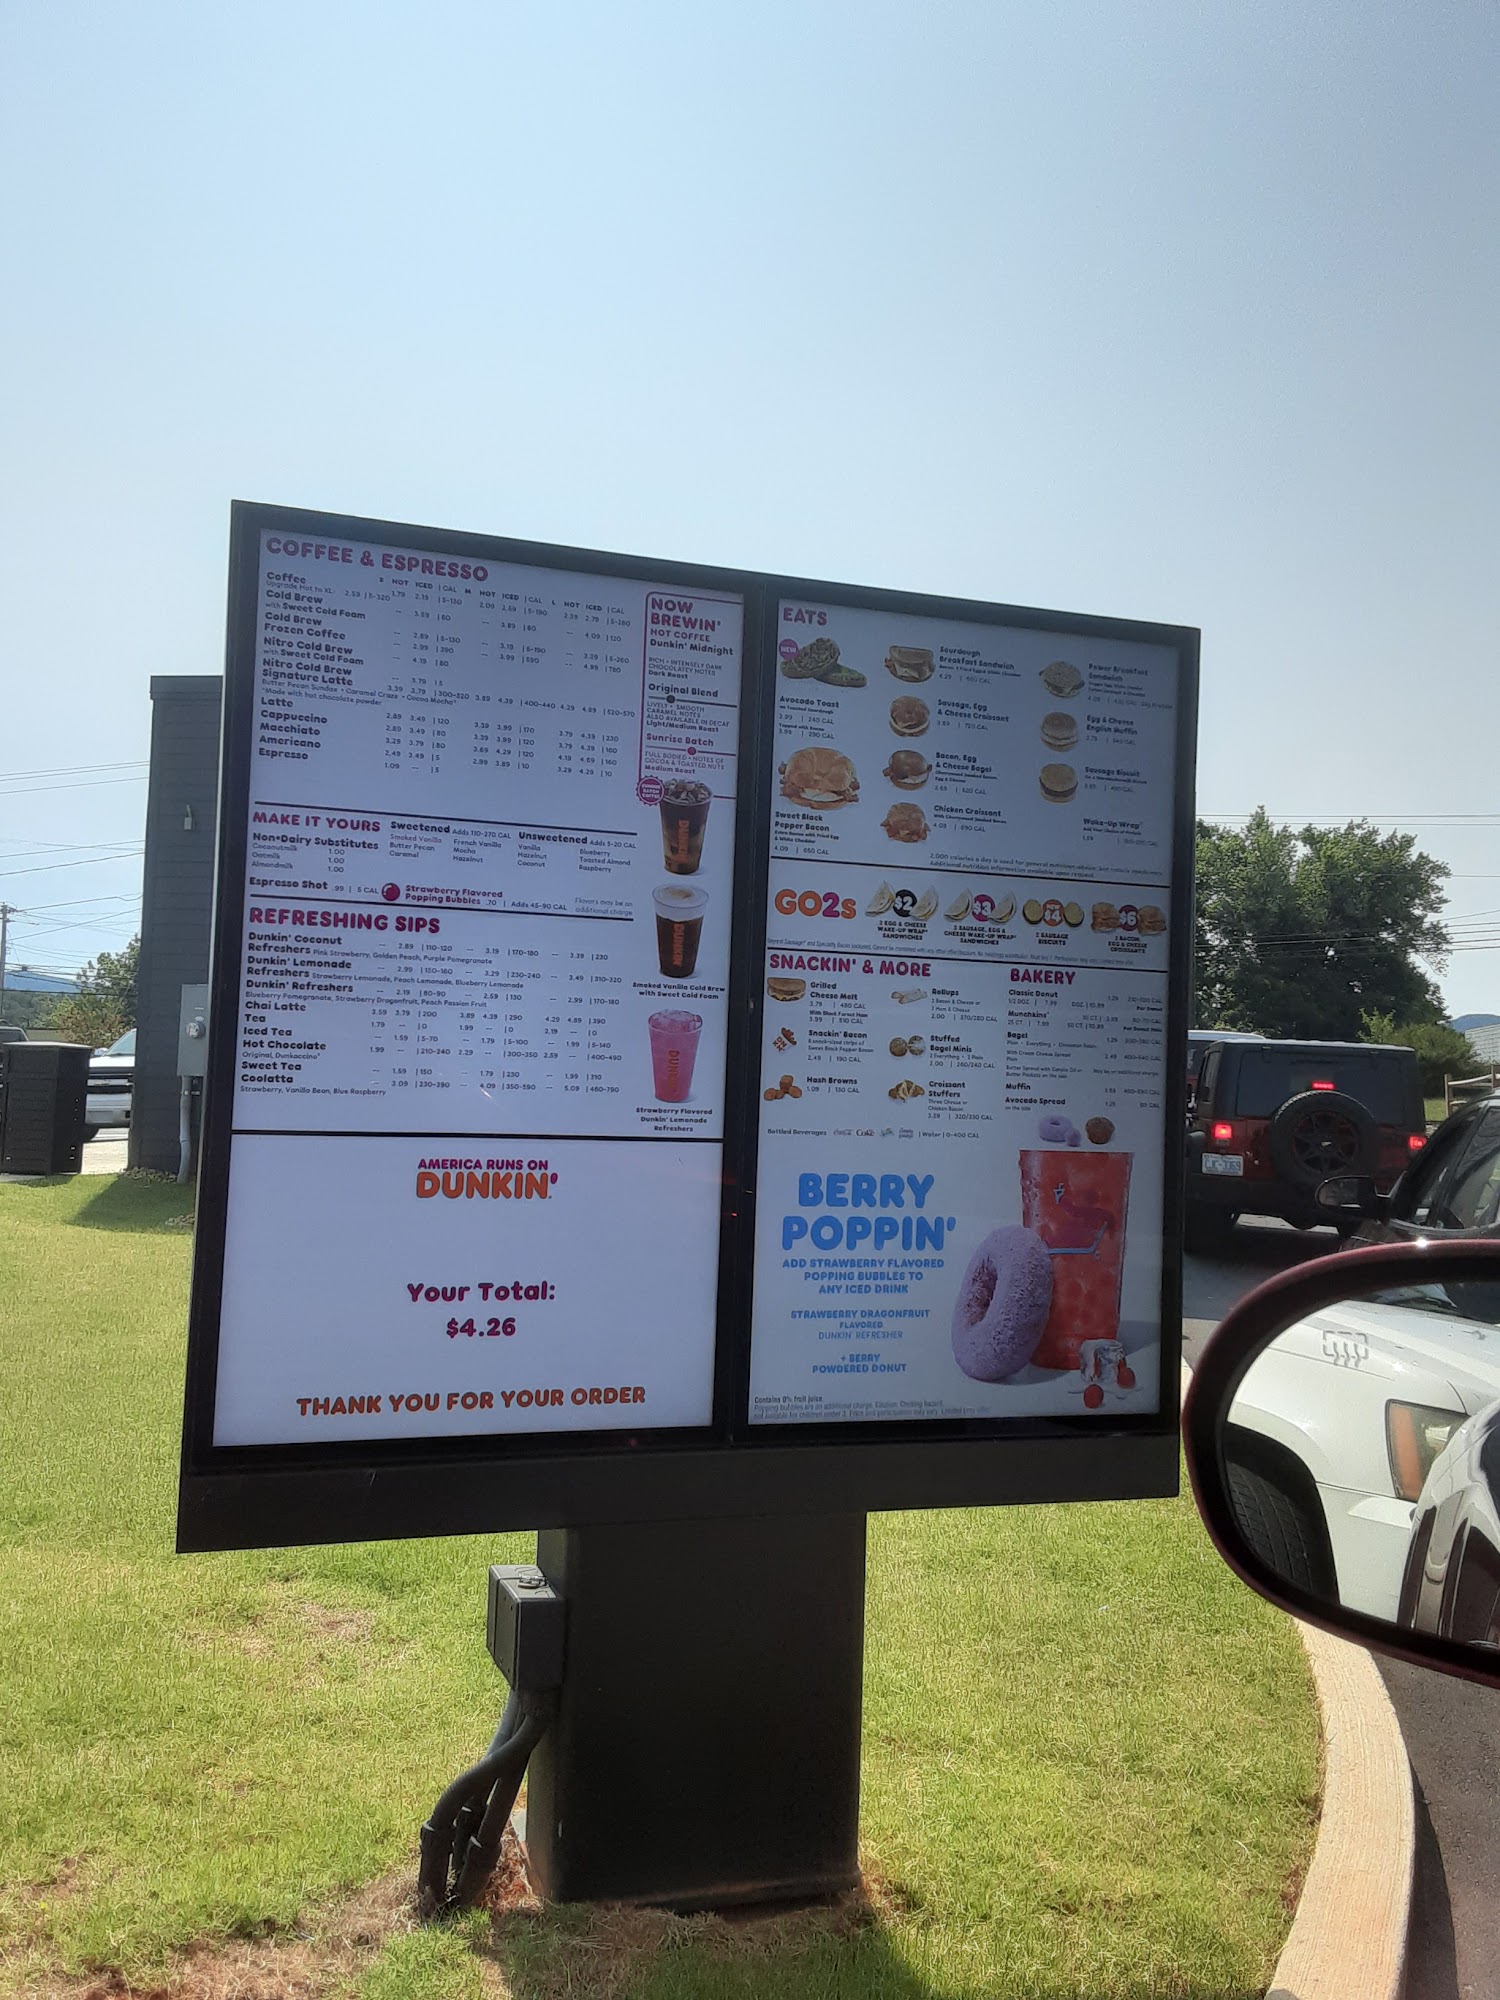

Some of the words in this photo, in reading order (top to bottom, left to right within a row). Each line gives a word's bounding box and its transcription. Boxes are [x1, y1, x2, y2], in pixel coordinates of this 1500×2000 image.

[266, 537, 353, 564] COFFEE
[360, 550, 375, 567] &
[381, 553, 488, 582] ESPRESSO
[266, 571, 306, 584] Coffee
[391, 578, 409, 586] HOT
[415, 581, 433, 589] ICED
[266, 589, 292, 600] Cold
[294, 592, 323, 604] Brew
[282, 602, 313, 613] Sweet
[315, 606, 337, 616] Cold
[339, 609, 366, 619] Foam
[651, 597, 693, 614] NOW
[650, 612, 721, 632] BREWIN'
[783, 607, 827, 626] EATS
[264, 622, 304, 635] Frozen
[306, 628, 346, 640] Coffee
[650, 627, 671, 637] HOT
[673, 631, 710, 643] COFFEE
[263, 636, 294, 648] Nitro
[296, 641, 322, 651] Cold
[324, 643, 353, 655] Brew
[650, 638, 687, 650] Dunkin'
[689, 643, 733, 656] Midnight
[262, 668, 319, 682] Signature
[321, 675, 353, 686] Latte
[648, 683, 689, 695] Original
[691, 687, 718, 698] Blend
[261, 696, 293, 708] Latte
[779, 695, 815, 705] Avocado
[816, 699, 839, 708] Toast
[260, 709, 328, 724] Cappuccino
[259, 722, 320, 736] Macchiato
[259, 735, 321, 749] Americano
[646, 732, 683, 744] Sunrise
[685, 736, 714, 747] Batch
[258, 747, 308, 760] Espresso
[775, 811, 800, 820] Sweet
[801, 813, 823, 821] Black
[933, 805, 964, 814] Chicken
[252, 811, 301, 826] MAKE
[305, 815, 321, 827] IT
[325, 817, 380, 832] YOURS
[390, 821, 451, 834] Sweetened
[774, 820, 804, 830] Pepper
[805, 823, 830, 832] Bacon
[314, 837, 379, 850] Substitutes
[453, 838, 477, 846] French
[518, 831, 588, 844] Unsweetened
[251, 842, 298, 851] Coconutmilk
[413, 843, 435, 852] Pecan
[453, 846, 476, 854] Mocha
[251, 851, 280, 859] Oatmilk
[389, 849, 419, 858] Caramel
[517, 851, 547, 859] Hazelnut
[251, 860, 293, 869] Almondmilk
[517, 859, 545, 868] Coconut
[578, 864, 611, 873] Raspberry
[248, 876, 299, 888] Espresso
[301, 880, 328, 890] Shot
[405, 884, 460, 897] Strawberry
[461, 888, 503, 898] Flavored
[405, 893, 444, 904] Popping
[445, 895, 481, 905] Bubbles
[774, 888, 856, 919] GO2s
[894, 894, 913, 912] $2
[972, 900, 992, 917] $3
[249, 907, 388, 931] REFRESHING
[394, 915, 440, 934] SIPS
[1119, 910, 1137, 927] $6
[248, 931, 291, 942] Dunkin'
[294, 934, 342, 945] Coconut
[247, 942, 311, 954] Refreshers
[247, 955, 290, 966] Dunkin'
[293, 958, 352, 969] Lemonade
[769, 953, 856, 973] SNACKIN'
[862, 959, 874, 974] &
[879, 960, 931, 977] MORE
[1010, 968, 1076, 985] BAKERY
[810, 981, 837, 990] Grilled
[809, 991, 838, 999] Cheese
[839, 993, 858, 1001] Melt
[1008, 989, 1034, 997] Classic
[1035, 990, 1058, 998] Donut
[245, 1000, 271, 1010] Chai
[274, 1002, 306, 1011] Latte
[244, 1013, 266, 1023] Tea
[243, 1026, 268, 1036] Iced
[270, 1027, 292, 1036] Tea
[242, 1039, 265, 1048] Hot
[267, 1040, 326, 1050] Chocolate
[241, 1061, 278, 1070] Sweet
[280, 1062, 302, 1071] Tea
[240, 1073, 293, 1083] Coolatta
[828, 1077, 858, 1085] Browns
[1005, 1082, 1031, 1090] Muffin
[417, 1158, 483, 1170] AMERICA
[486, 1159, 523, 1170] RUNS
[527, 1159, 548, 1171] ON
[798, 1172, 934, 1209] BERRY
[782, 1215, 956, 1251] POPPIN'
[782, 1258, 807, 1268] ADD
[810, 1258, 884, 1268] STRAWBERRY
[887, 1258, 944, 1268] FLAVORED
[804, 1271, 855, 1281] POPPING
[857, 1271, 905, 1281] BUBBLES
[908, 1271, 923, 1281] TO
[407, 1283, 471, 1303] Your
[477, 1280, 555, 1301] Total:
[818, 1284, 843, 1294] ANY
[845, 1284, 871, 1294] ICED
[874, 1284, 908, 1293] DRINK
[790, 1309, 858, 1319] STRAWBERRY
[860, 1309, 930, 1318] DRAGONFRUIT
[446, 1317, 516, 1339] $4.26
[855, 1330, 903, 1339] REFRESHER
[849, 1353, 880, 1363] BERRY
[812, 1364, 869, 1374] POWDERED
[871, 1363, 907, 1373] DONUT
[295, 1394, 382, 1416] THANK
[388, 1392, 440, 1413] YOU
[446, 1391, 494, 1411] FOR
[500, 1389, 564, 1408] YOUR
[570, 1386, 646, 1406] ORDER
